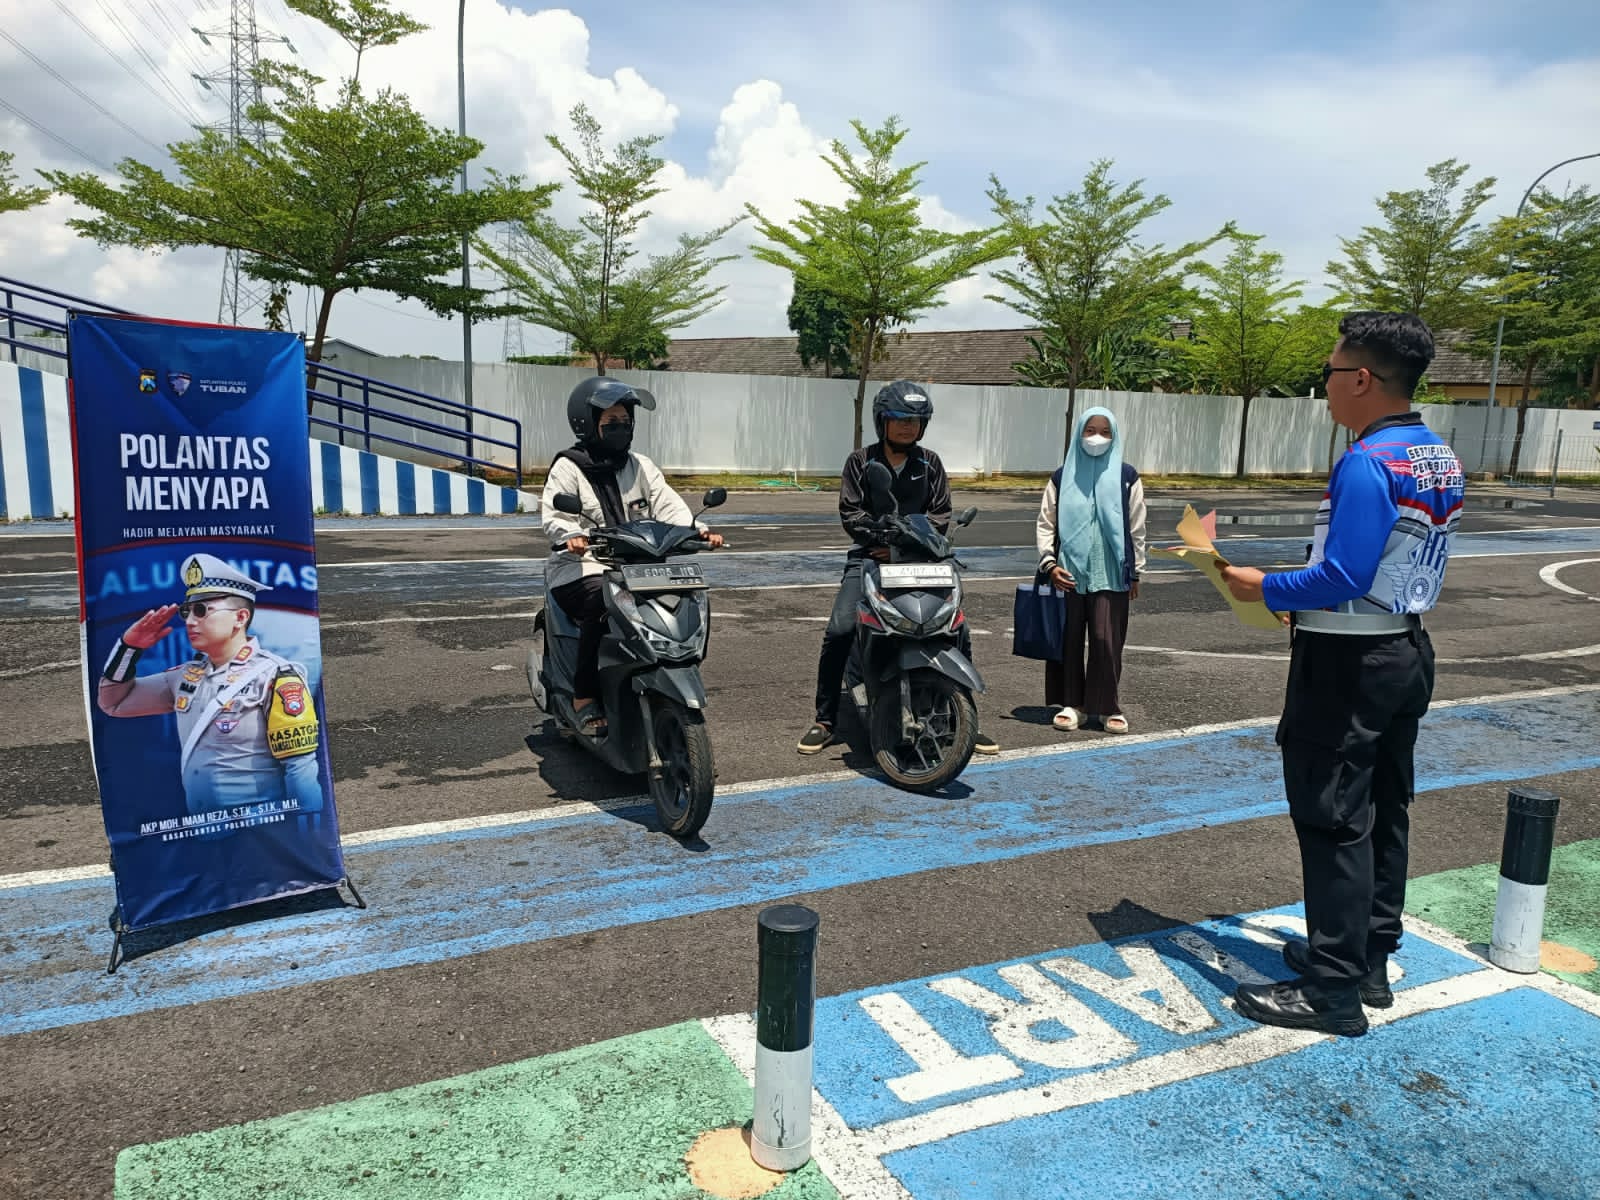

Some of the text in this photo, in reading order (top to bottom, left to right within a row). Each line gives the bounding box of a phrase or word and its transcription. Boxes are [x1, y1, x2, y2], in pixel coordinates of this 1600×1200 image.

[199, 384, 247, 394] TUBAN
[120, 433, 271, 470] POLANTAS
[126, 476, 270, 511] MENYAPA
[123, 525, 275, 538] HADIR MELAYANI MASYARAKAT
[86, 560, 174, 602] ALU
[140, 823, 158, 835] AKP
[182, 814, 205, 827] IMAM
[224, 818, 256, 831] POLRES
